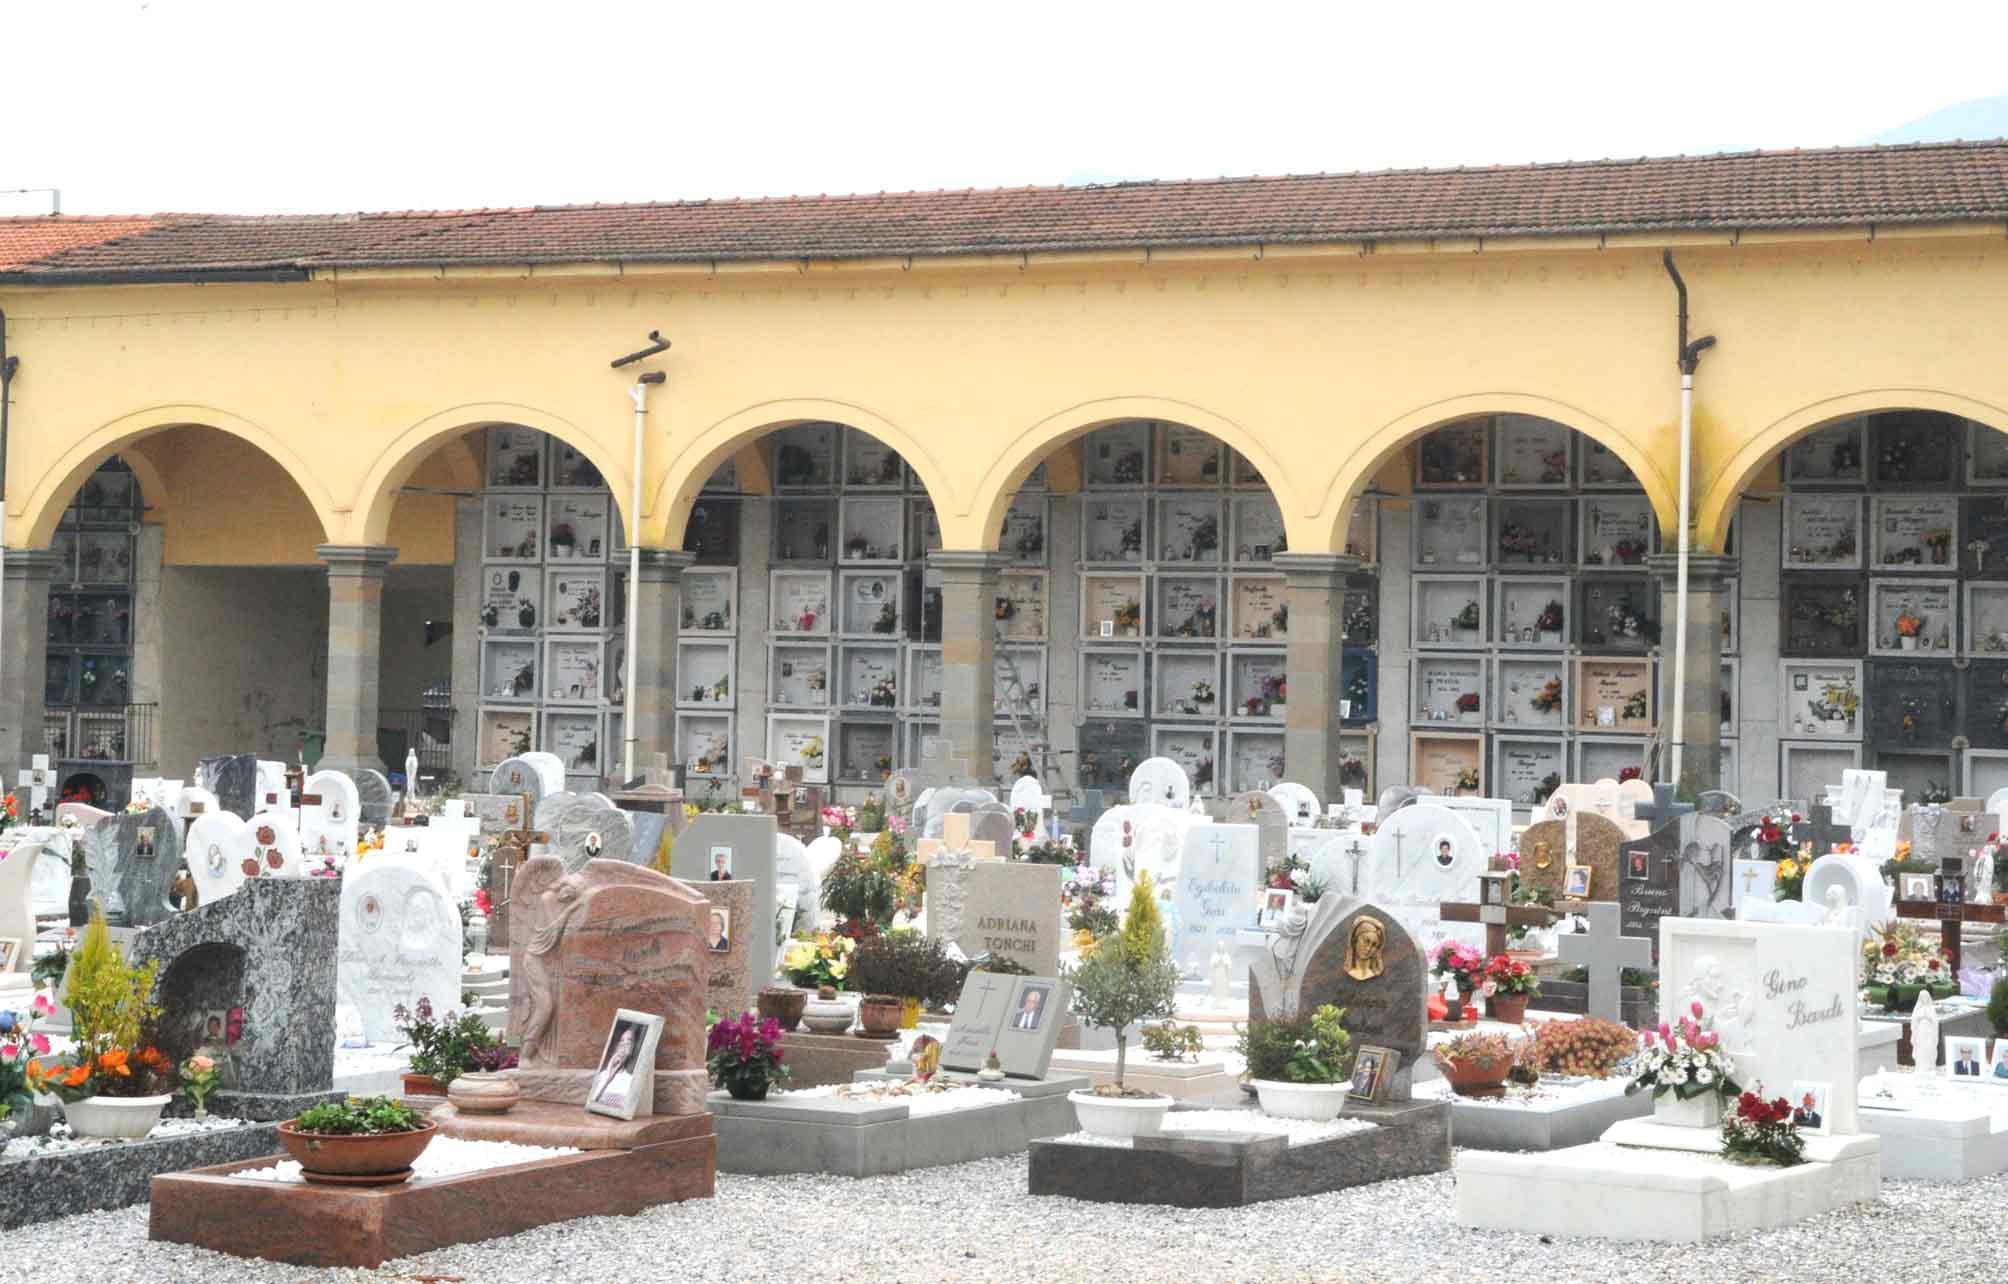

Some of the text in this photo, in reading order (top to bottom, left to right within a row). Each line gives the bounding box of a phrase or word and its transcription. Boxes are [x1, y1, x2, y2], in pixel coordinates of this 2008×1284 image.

[977, 917, 1037, 934] ADRIANA
[983, 936, 1037, 952] TONCHI
[1762, 969, 1808, 1000] Gino
